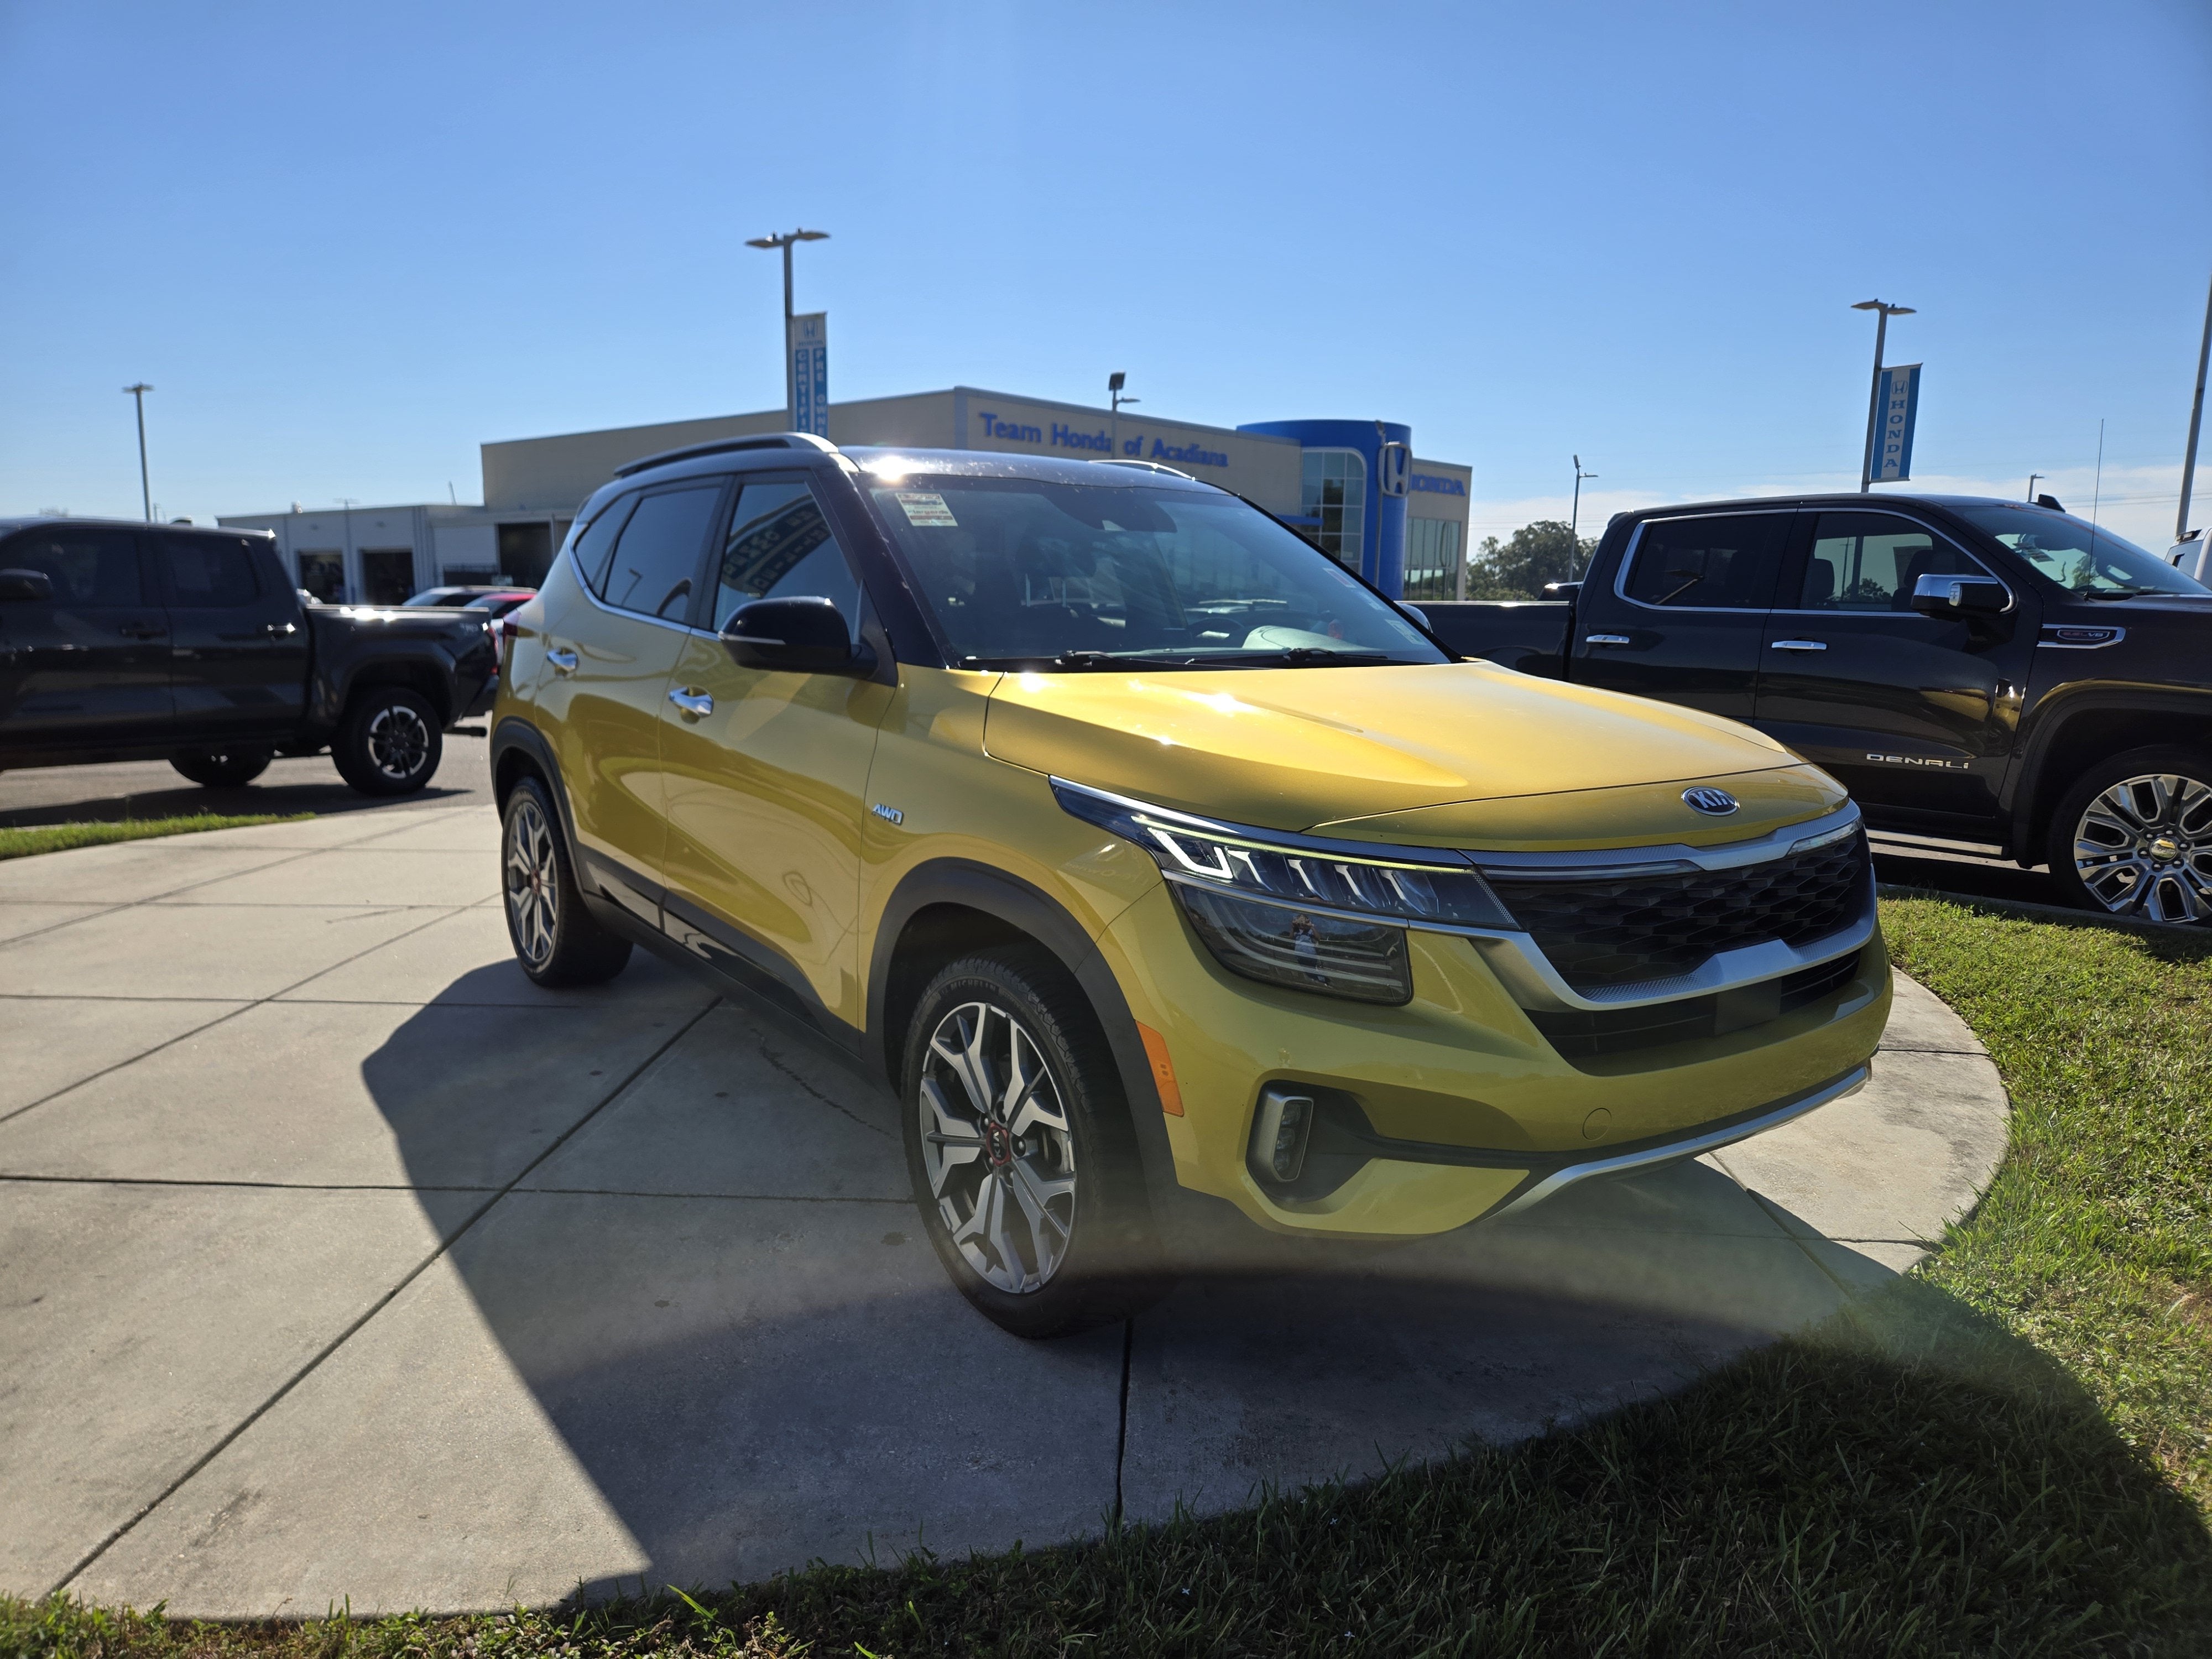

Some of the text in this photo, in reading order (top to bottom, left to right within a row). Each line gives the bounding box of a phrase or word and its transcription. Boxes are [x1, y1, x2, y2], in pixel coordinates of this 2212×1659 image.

[797, 351, 807, 432] CERTIFI
[979, 411, 1042, 443] Team
[1124, 435, 1144, 456] of
[1151, 437, 1229, 467] Acadiana
[1884, 400, 1905, 468] HONDA
[1866, 753, 1969, 770] DENALI
[1689, 790, 1735, 808] KIA
[872, 803, 904, 825] AWD
[951, 979, 997, 992] MICHELIN
[993, 1131, 1001, 1158] KIA
